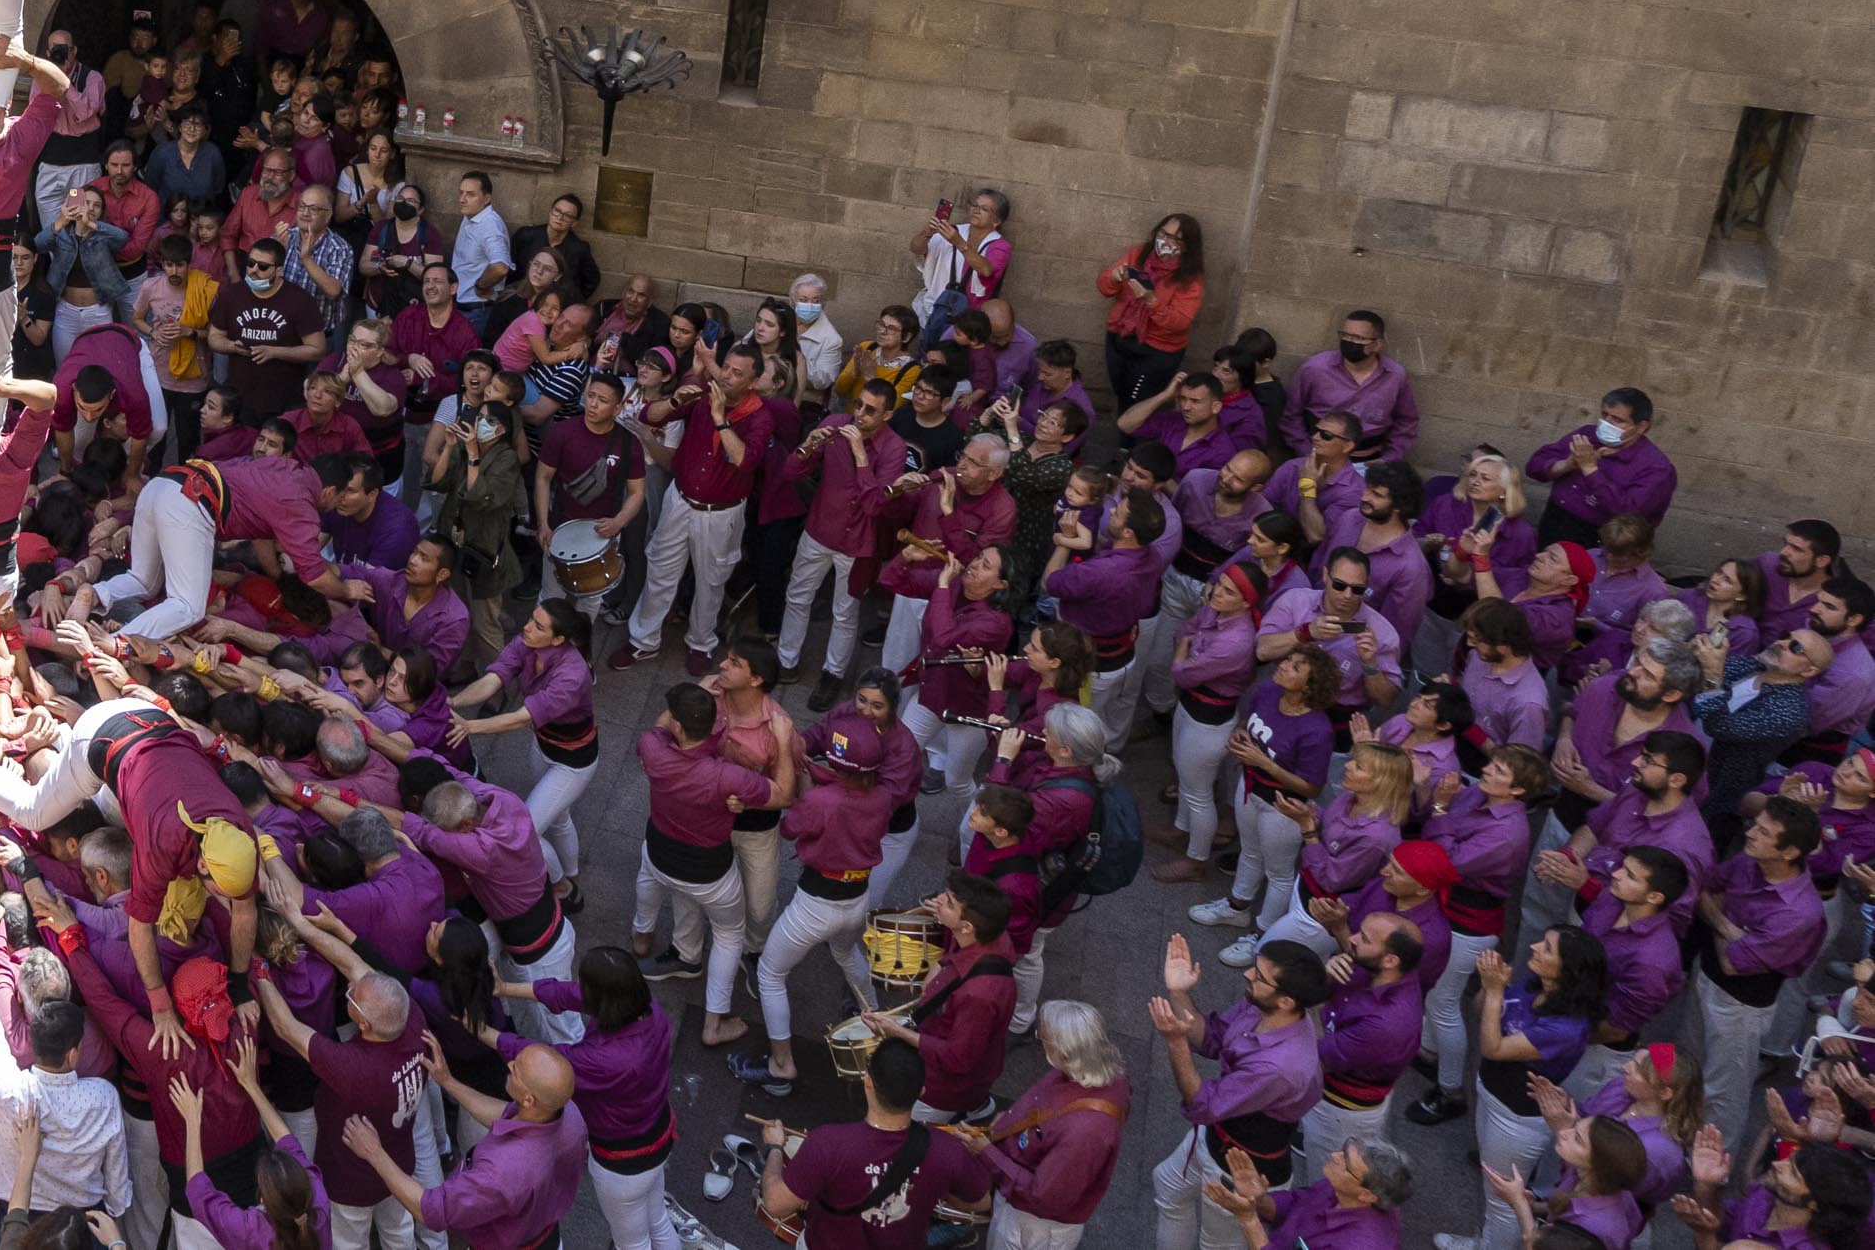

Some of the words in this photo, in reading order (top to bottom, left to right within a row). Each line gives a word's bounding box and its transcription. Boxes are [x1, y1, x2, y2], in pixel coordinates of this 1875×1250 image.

[236, 308, 287, 329] PHOENIX
[241, 328, 277, 340] ARIZONA
[392, 1071, 402, 1083] de
[865, 1163, 880, 1174] de
